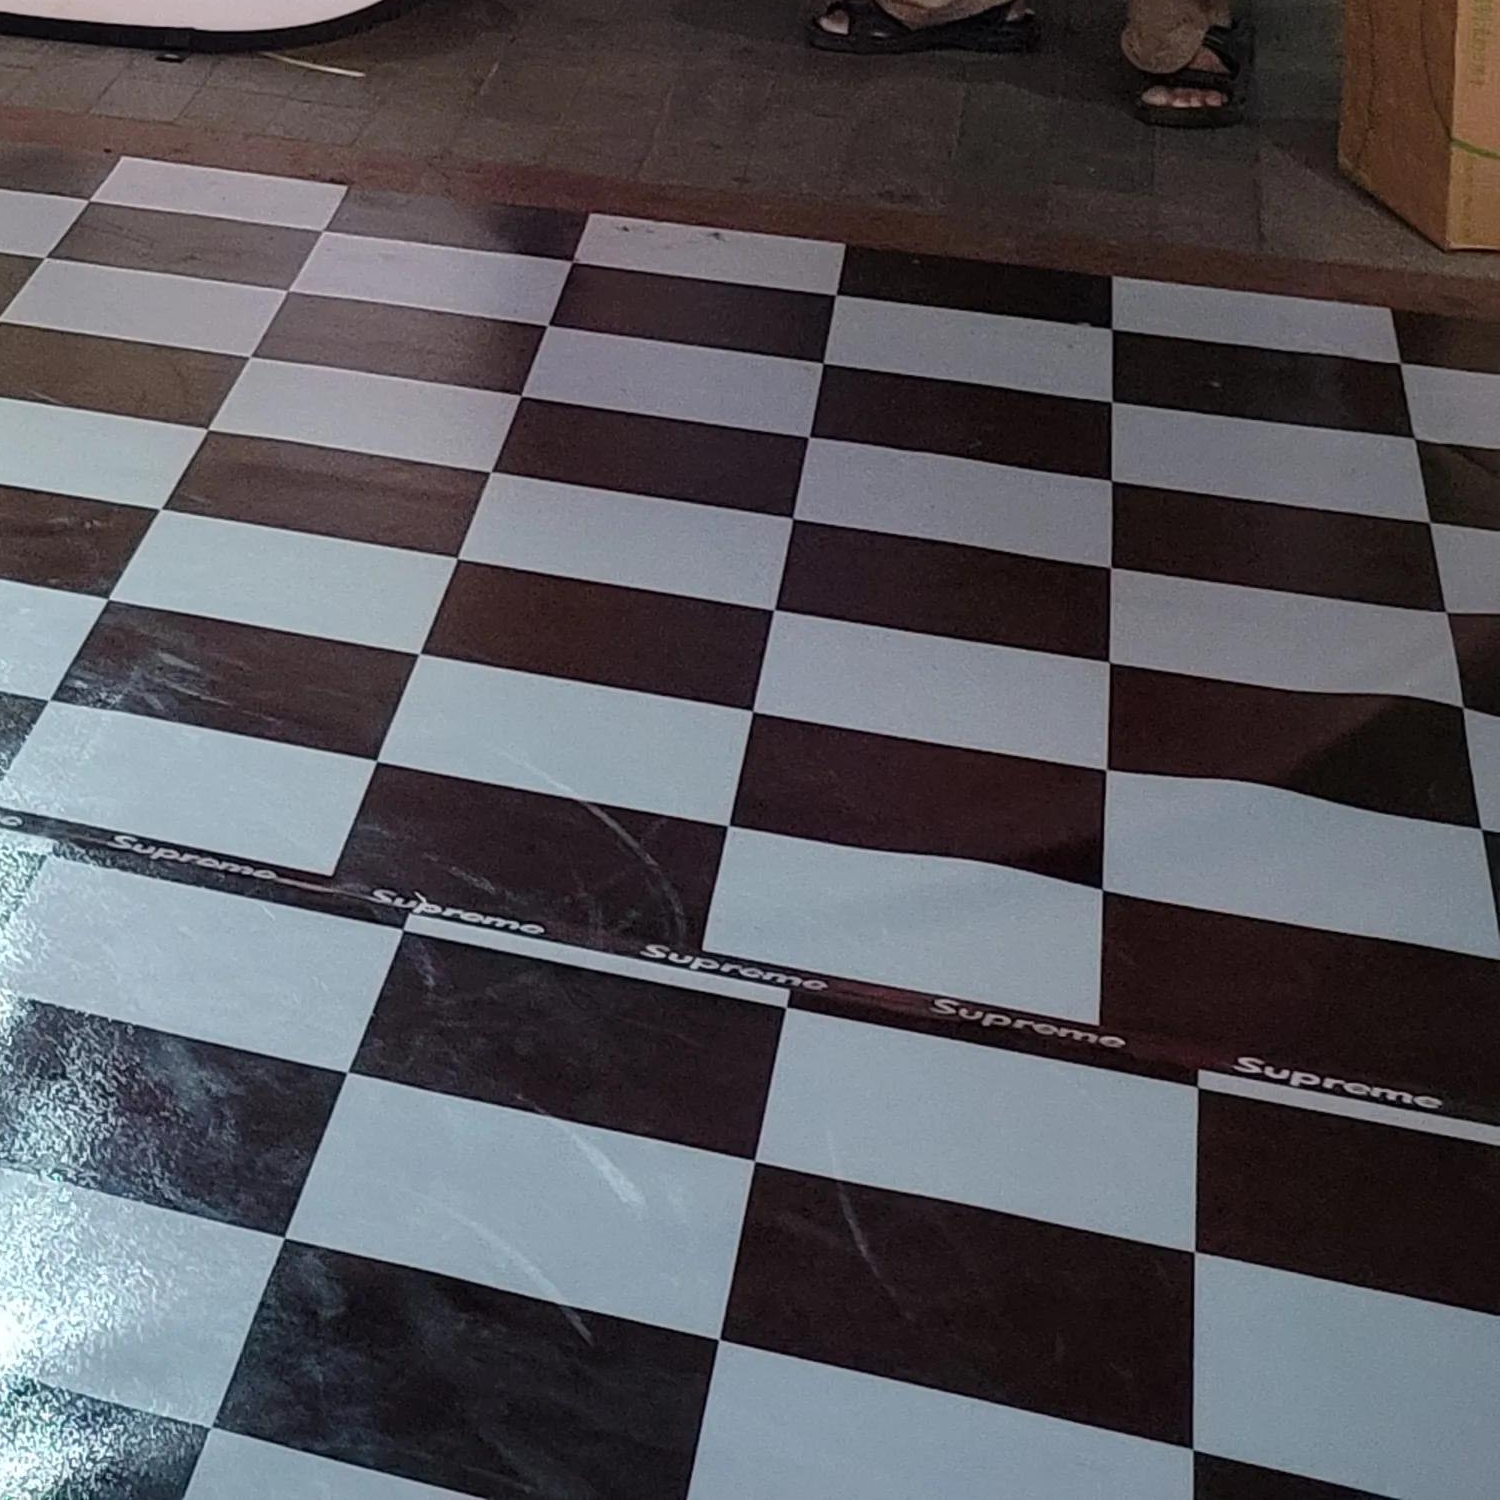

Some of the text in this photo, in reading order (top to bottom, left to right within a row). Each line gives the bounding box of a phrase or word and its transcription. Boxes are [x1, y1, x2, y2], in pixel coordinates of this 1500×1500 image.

[106, 833, 280, 881] Supreme
[368, 887, 547, 937] Supreme
[638, 943, 830, 993] Supreme
[928, 998, 1128, 1050] Supreme
[1233, 1055, 1445, 1111] Supreme
